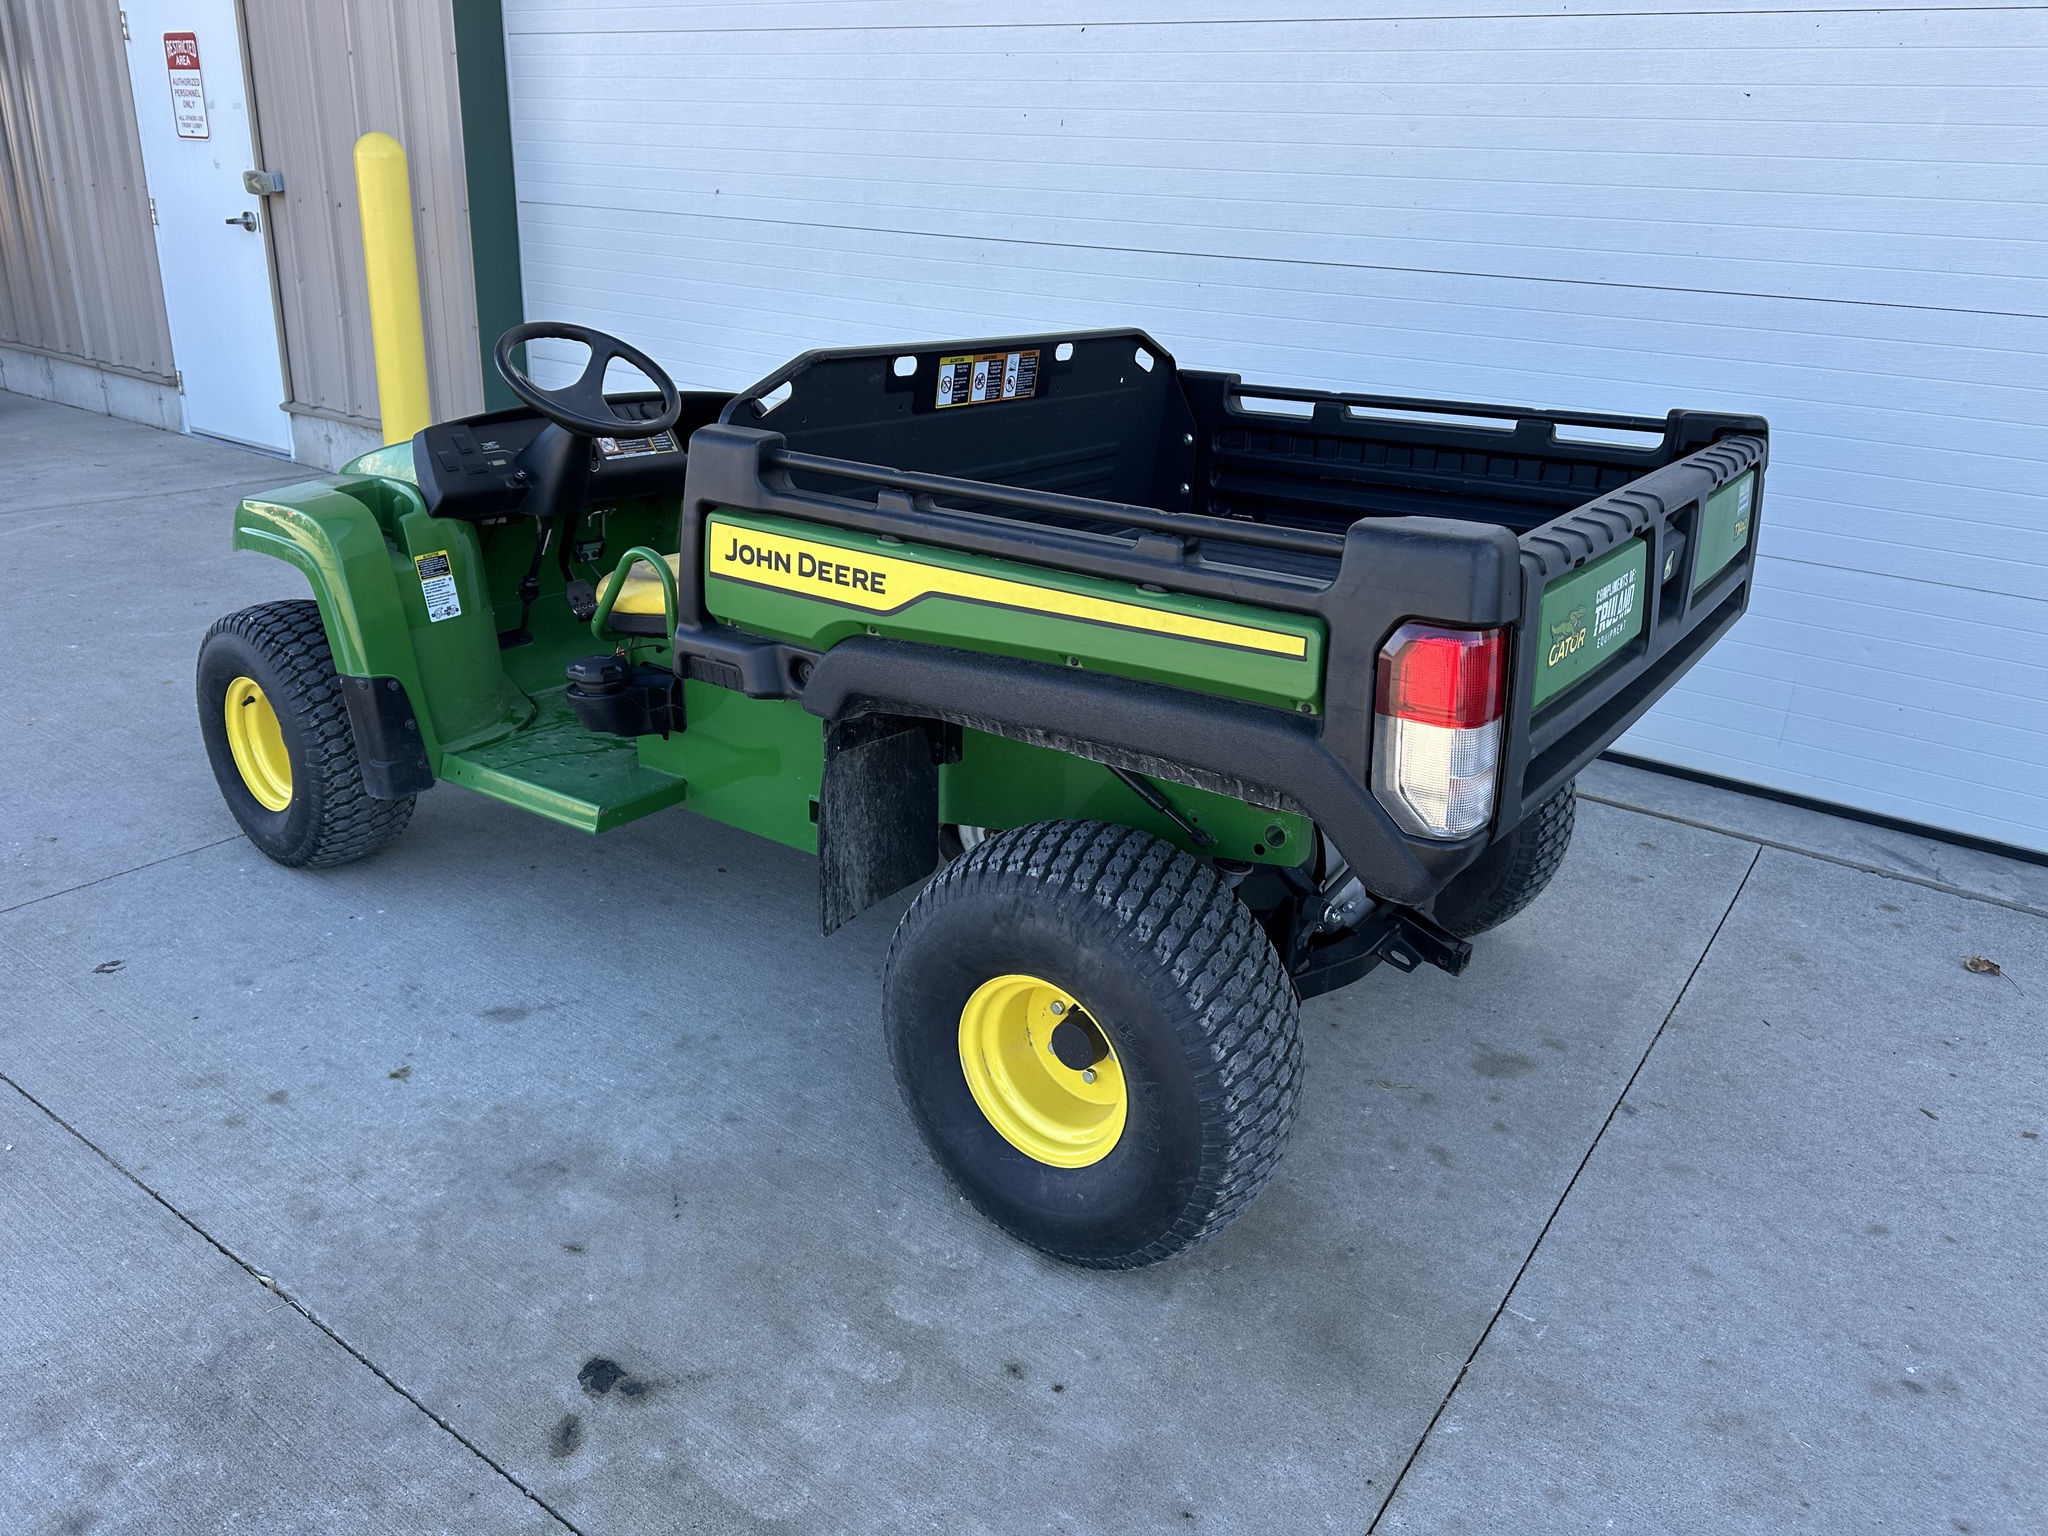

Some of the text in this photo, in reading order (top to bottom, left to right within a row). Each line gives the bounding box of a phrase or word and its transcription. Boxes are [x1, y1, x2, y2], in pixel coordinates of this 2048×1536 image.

[166, 40, 196, 58] RESTRICTED
[176, 55, 191, 65] AREA
[173, 78, 200, 87] AUTHORIZED
[174, 89, 201, 98] PERSONNEL
[725, 538, 886, 594] JOHN DEERE
[1596, 572, 1629, 604] COMPLIMENTS
[1593, 584, 1635, 637] TRULAND
[1548, 627, 1586, 667] GATOR
[1597, 620, 1627, 649] EQUIPMENT
